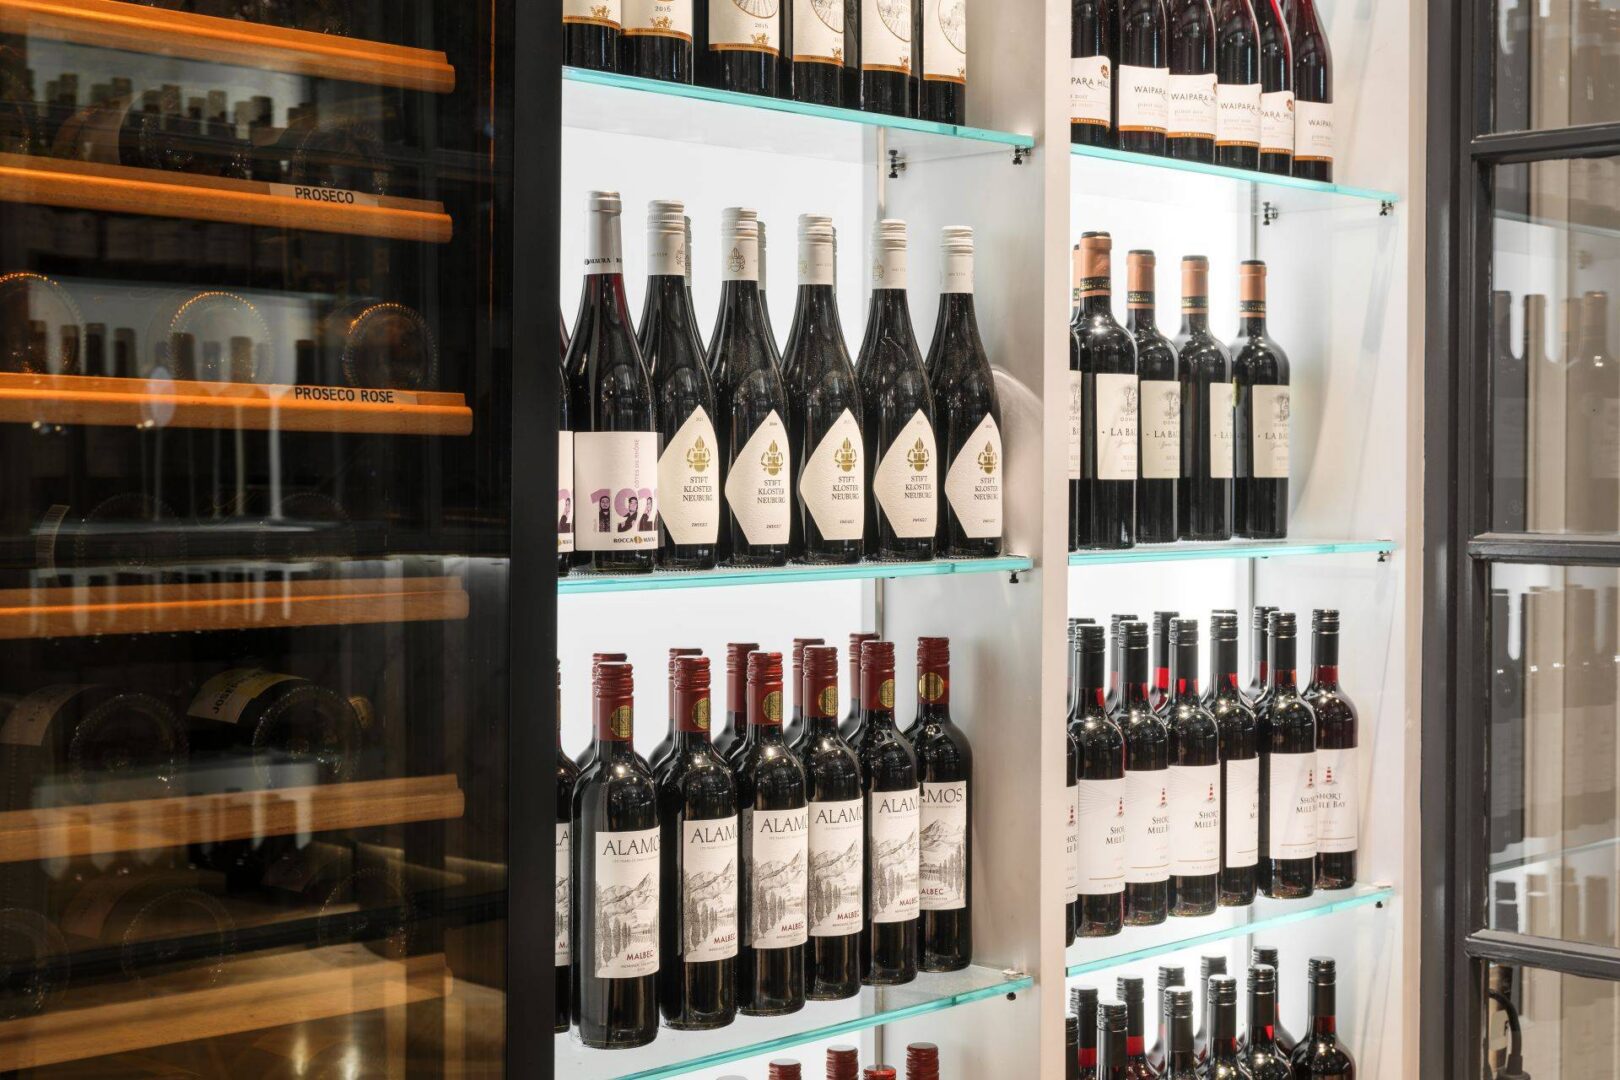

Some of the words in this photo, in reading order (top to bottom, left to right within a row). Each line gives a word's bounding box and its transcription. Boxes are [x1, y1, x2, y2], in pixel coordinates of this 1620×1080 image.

[1171, 93, 1210, 106] WAIPARA
[1221, 102, 1256, 114] WAIPARA
[294, 186, 355, 204] PROSECO
[294, 386, 355, 402] PROSECO
[361, 389, 395, 404] ROSE
[690, 476, 709, 484] STIFT
[764, 479, 782, 487] STIFT
[683, 485, 713, 493] KLOSTER
[832, 484, 859, 492] KLOSTER
[905, 483, 932, 491] KLOSTER
[682, 494, 713, 502] NEUBURG
[831, 493, 860, 501] NEUBURG
[590, 488, 658, 533] 192
[613, 536, 634, 544] ROCCA
[1334, 800, 1346, 809] BAY
[1296, 805, 1312, 814] MILE
[1194, 820, 1212, 829] MILE
[1147, 826, 1164, 834] MILE
[837, 909, 860, 921] MALBEC
[781, 921, 805, 933] MALBEC
[714, 932, 736, 945] MALBEC
[626, 949, 655, 961] MALBEC
